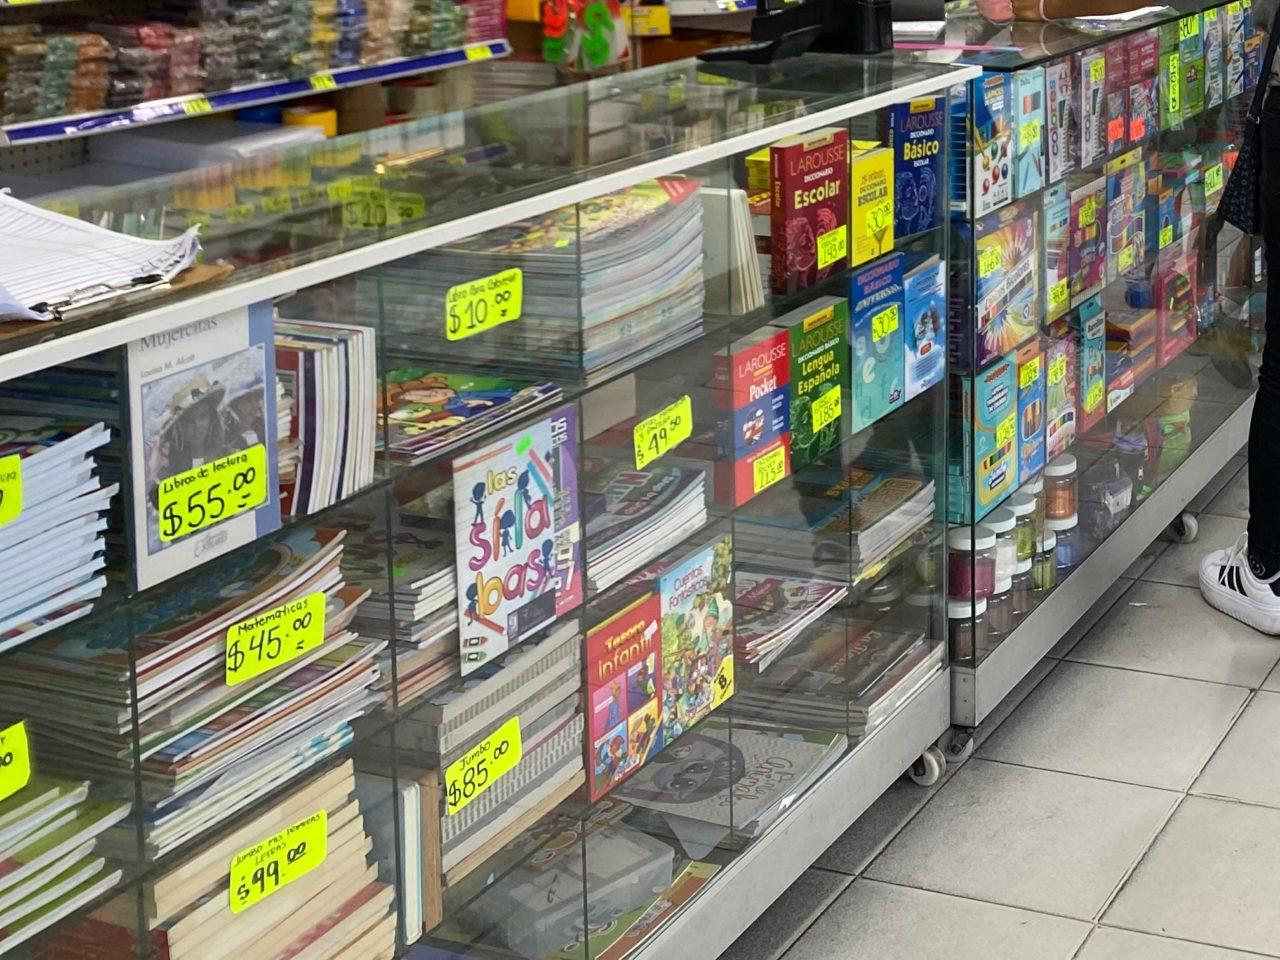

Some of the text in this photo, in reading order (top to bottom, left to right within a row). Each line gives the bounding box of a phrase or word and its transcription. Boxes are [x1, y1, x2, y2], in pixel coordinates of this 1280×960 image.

[900, 112, 943, 132] LAROUSSE
[790, 144, 845, 176] LAROUSSE
[903, 138, 939, 160] Básico
[804, 167, 833, 183] DICCIONARIO
[794, 179, 841, 210] Escolar
[738, 342, 787, 378] LAROUSSE
[802, 351, 834, 376] Lengua
[750, 374, 777, 403] Pocket
[797, 362, 840, 395] Española
[163, 473, 196, 494] Libros
[212, 453, 248, 473] lectura
[487, 466, 518, 495] las
[163, 466, 256, 537] $55.00
[468, 494, 551, 572] síla
[474, 548, 543, 620] bas
[673, 563, 704, 591] Cuentos
[228, 612, 312, 672] $45.00
[605, 620, 646, 650] Tesoro
[459, 741, 490, 771] Jumbo
[449, 740, 509, 807] $85.00
